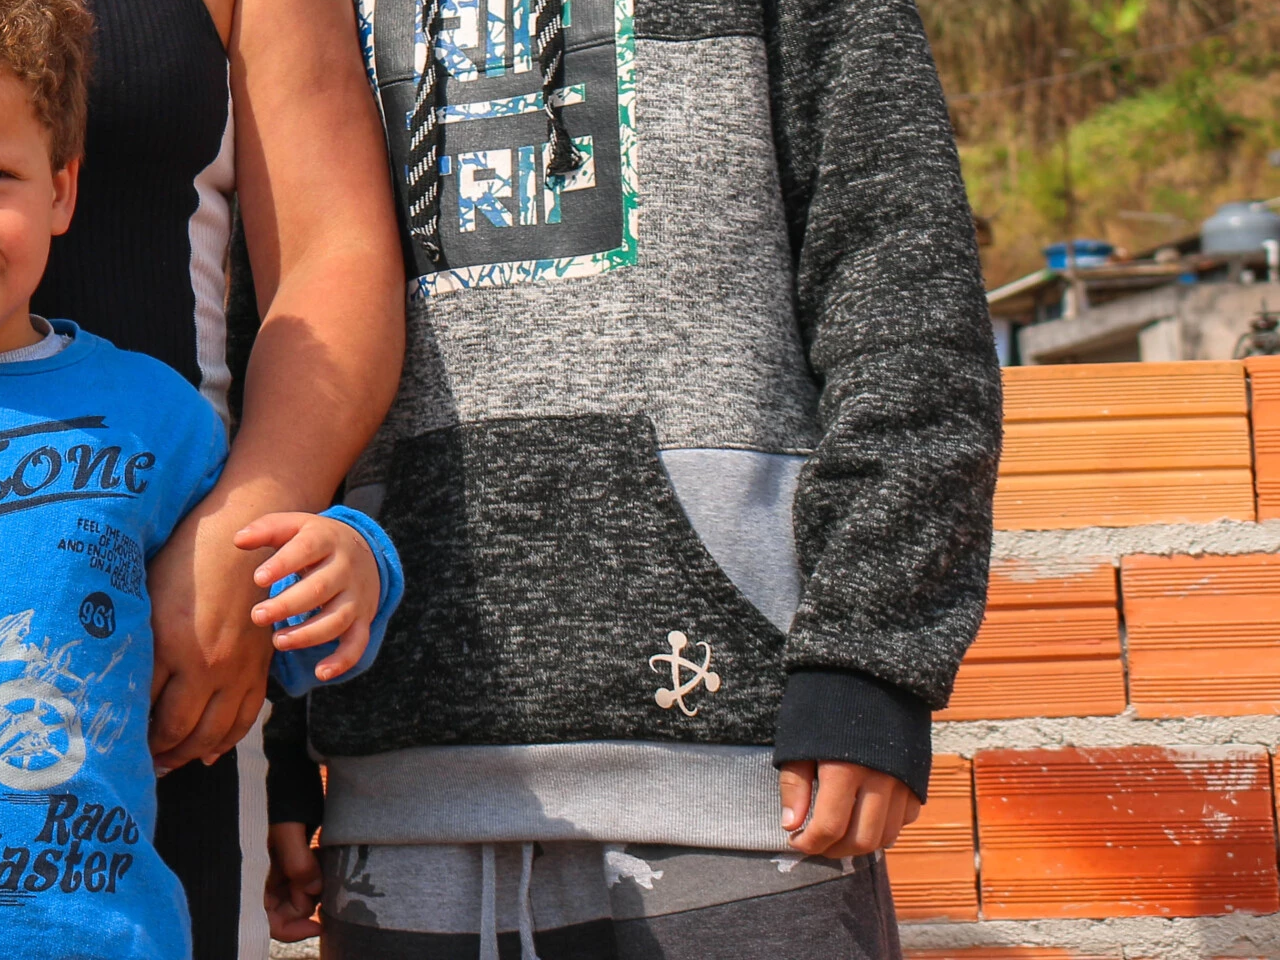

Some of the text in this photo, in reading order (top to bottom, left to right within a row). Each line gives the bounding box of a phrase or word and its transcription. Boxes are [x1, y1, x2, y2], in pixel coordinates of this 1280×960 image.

[406, 136, 596, 233] RIP
[77, 518, 100, 534] FEEL
[105, 524, 120, 541] THE
[99, 535, 111, 548] OF
[57, 538, 85, 554] AND
[87, 543, 118, 564] ENJOY
[90, 556, 104, 572] ON
[80, 601, 114, 633] 961
